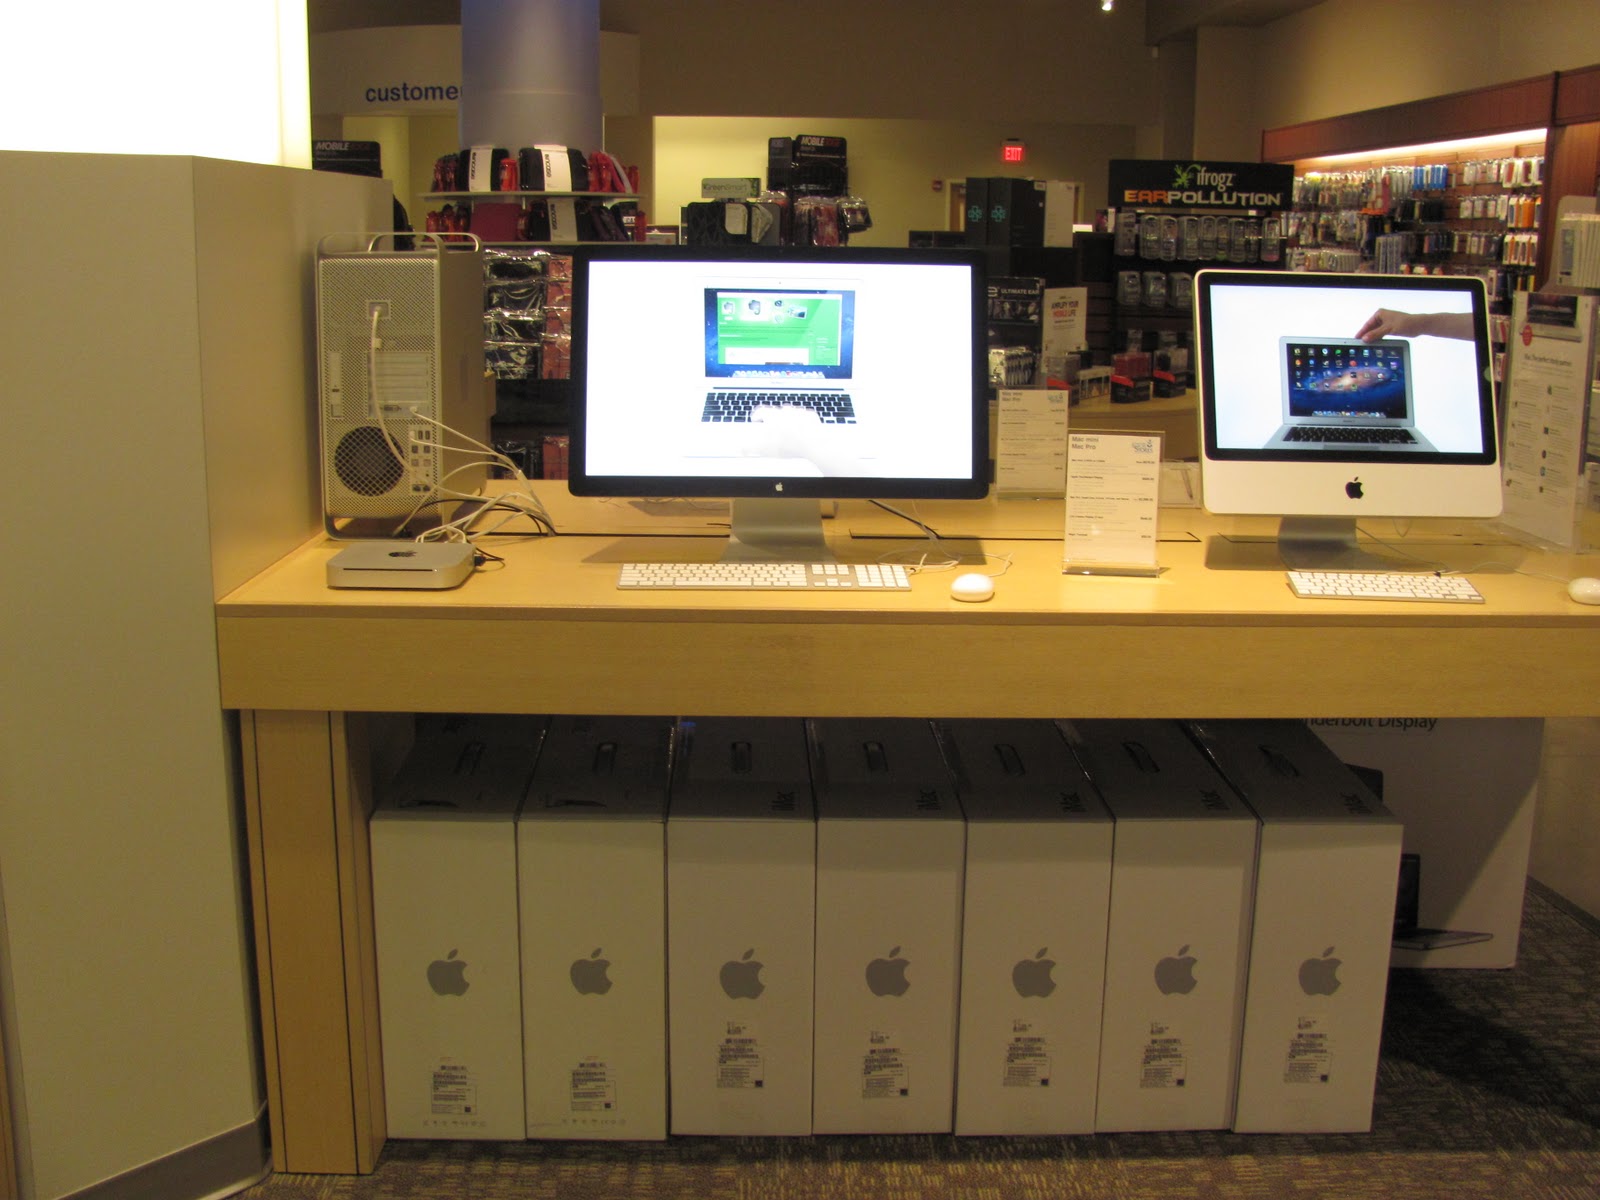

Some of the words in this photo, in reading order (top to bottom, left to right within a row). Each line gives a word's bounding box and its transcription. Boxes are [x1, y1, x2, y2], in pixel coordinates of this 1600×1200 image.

[365, 82, 463, 103] custome
[316, 141, 350, 151] MOBILE
[801, 136, 825, 147] MOBILE
[1004, 146, 1023, 161] EXIT
[1196, 166, 1234, 193] ifrogz
[1123, 189, 1281, 207] EARPOLLUTION
[1085, 443, 1097, 451] Pro
